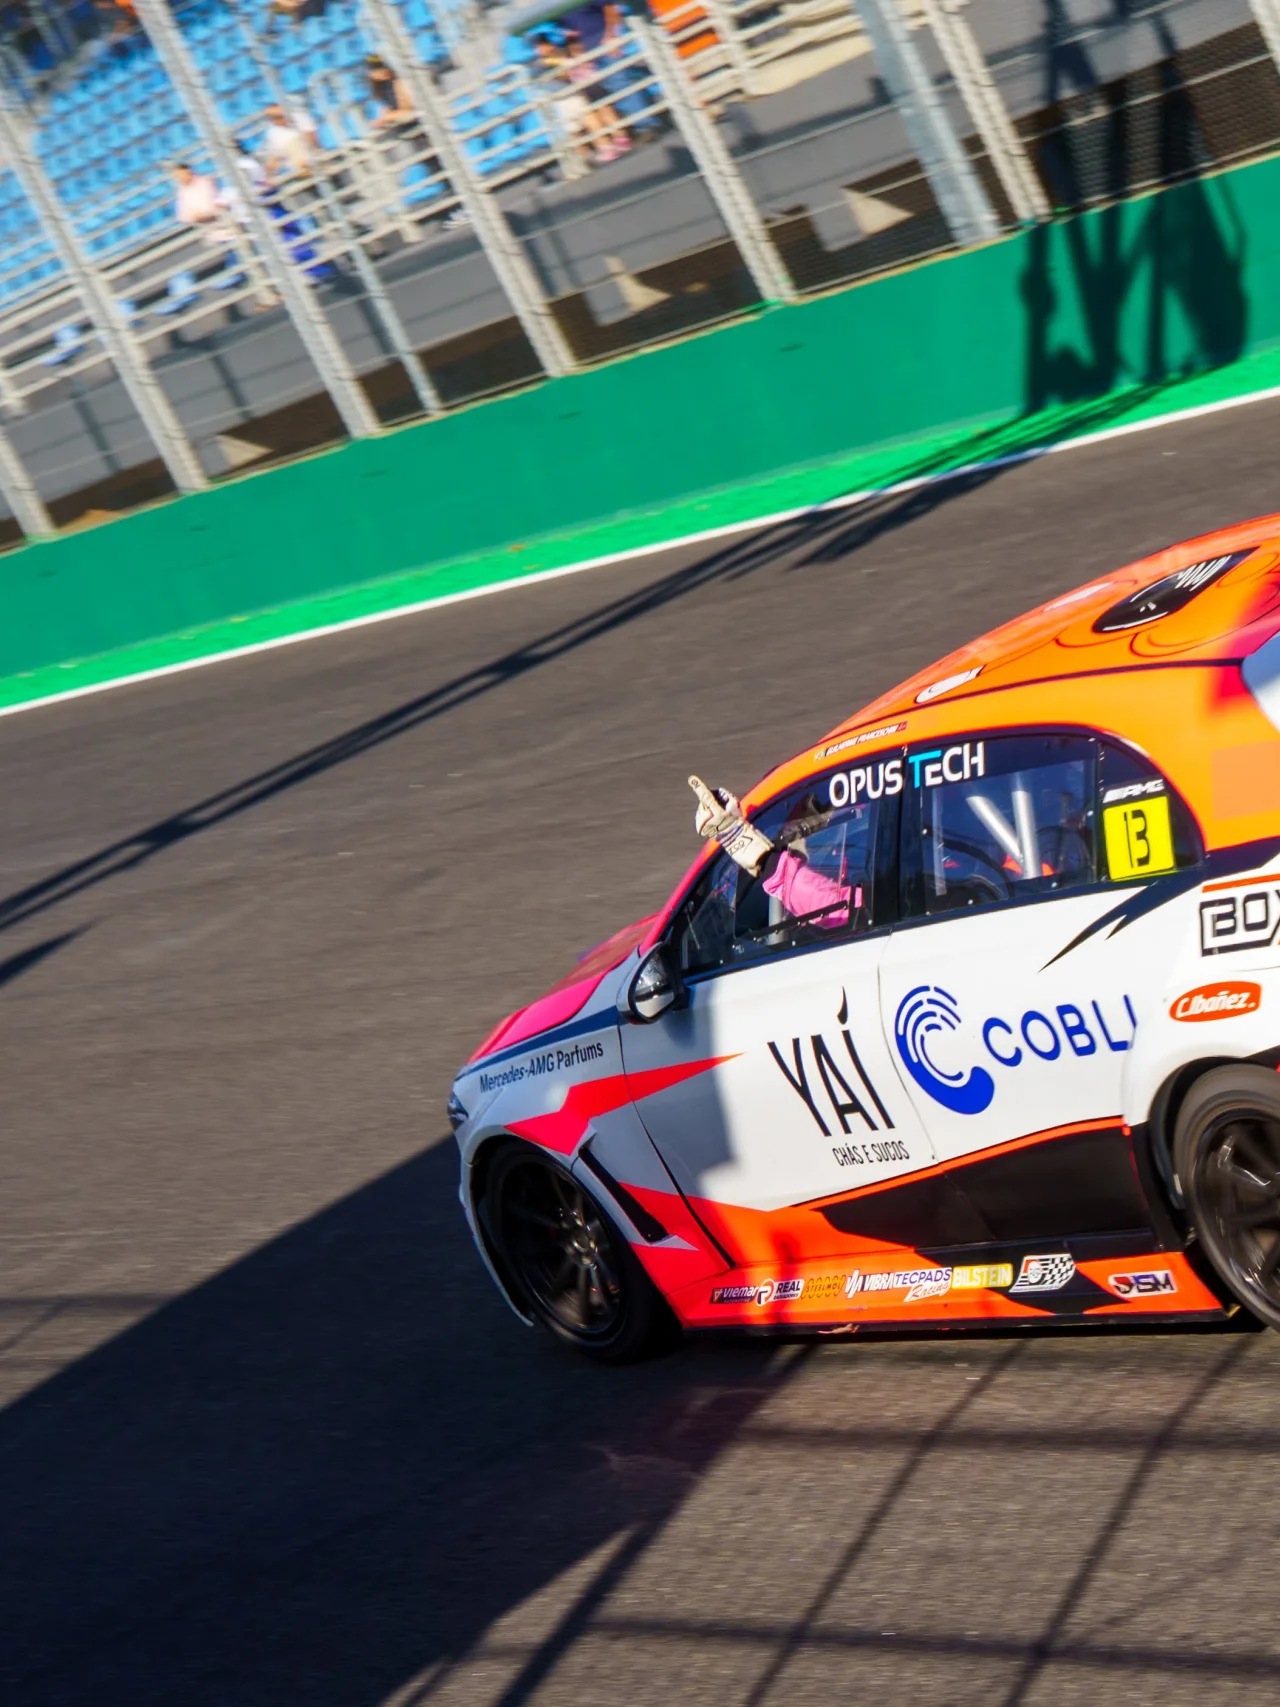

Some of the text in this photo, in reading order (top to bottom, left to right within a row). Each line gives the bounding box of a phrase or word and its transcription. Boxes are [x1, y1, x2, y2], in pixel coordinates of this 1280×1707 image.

[829, 741, 986, 808] OPUS TECH
[1123, 809, 1151, 869] 13
[982, 994, 1138, 1067] COBLI
[480, 1042, 604, 1093] Mercedes-AMG Parfums
[832, 1140, 910, 1166] CHÁS E SUCOS
[775, 1280, 801, 1293] REAL
[953, 1267, 1011, 1288] BILSTEIN
